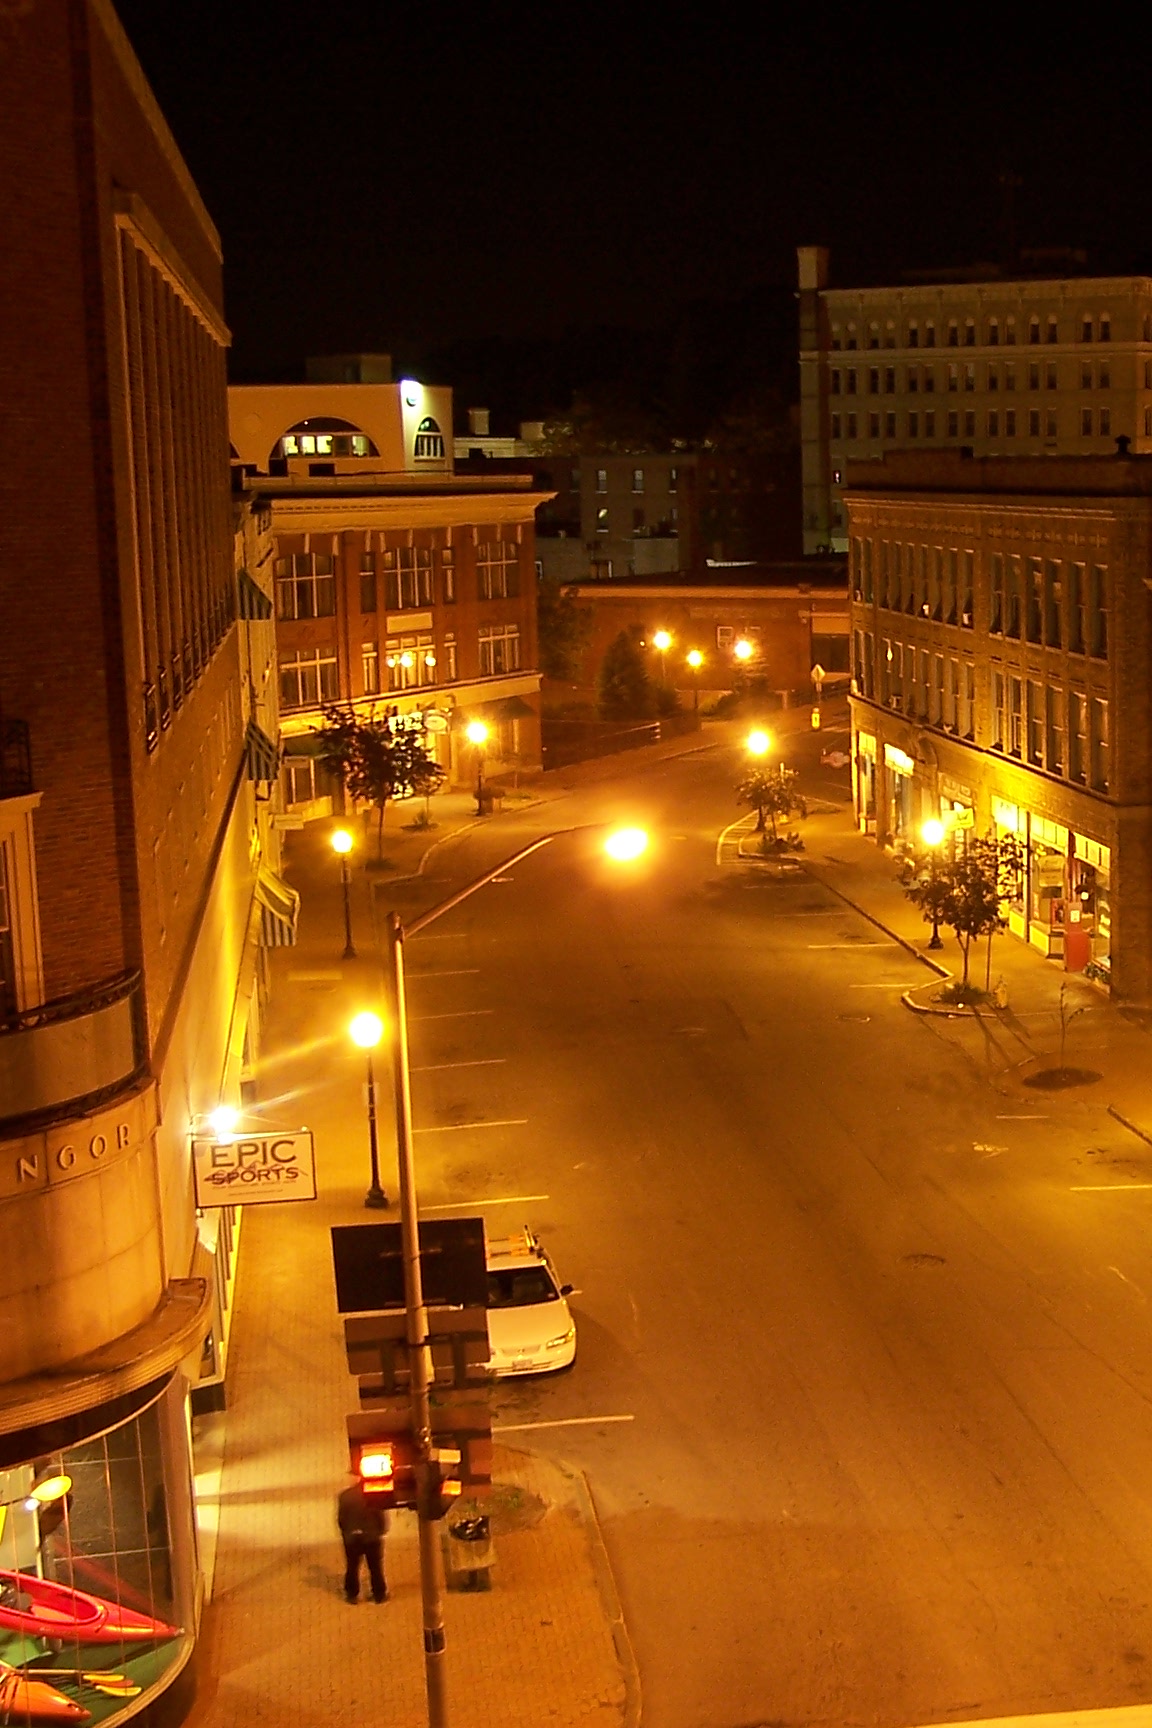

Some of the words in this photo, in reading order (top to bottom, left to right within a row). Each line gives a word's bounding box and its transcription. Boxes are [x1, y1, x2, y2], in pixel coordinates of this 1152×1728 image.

[17, 1123, 130, 1183] NGOR
[211, 1140, 297, 1168] EPIC
[211, 1167, 299, 1186] SPORTS
